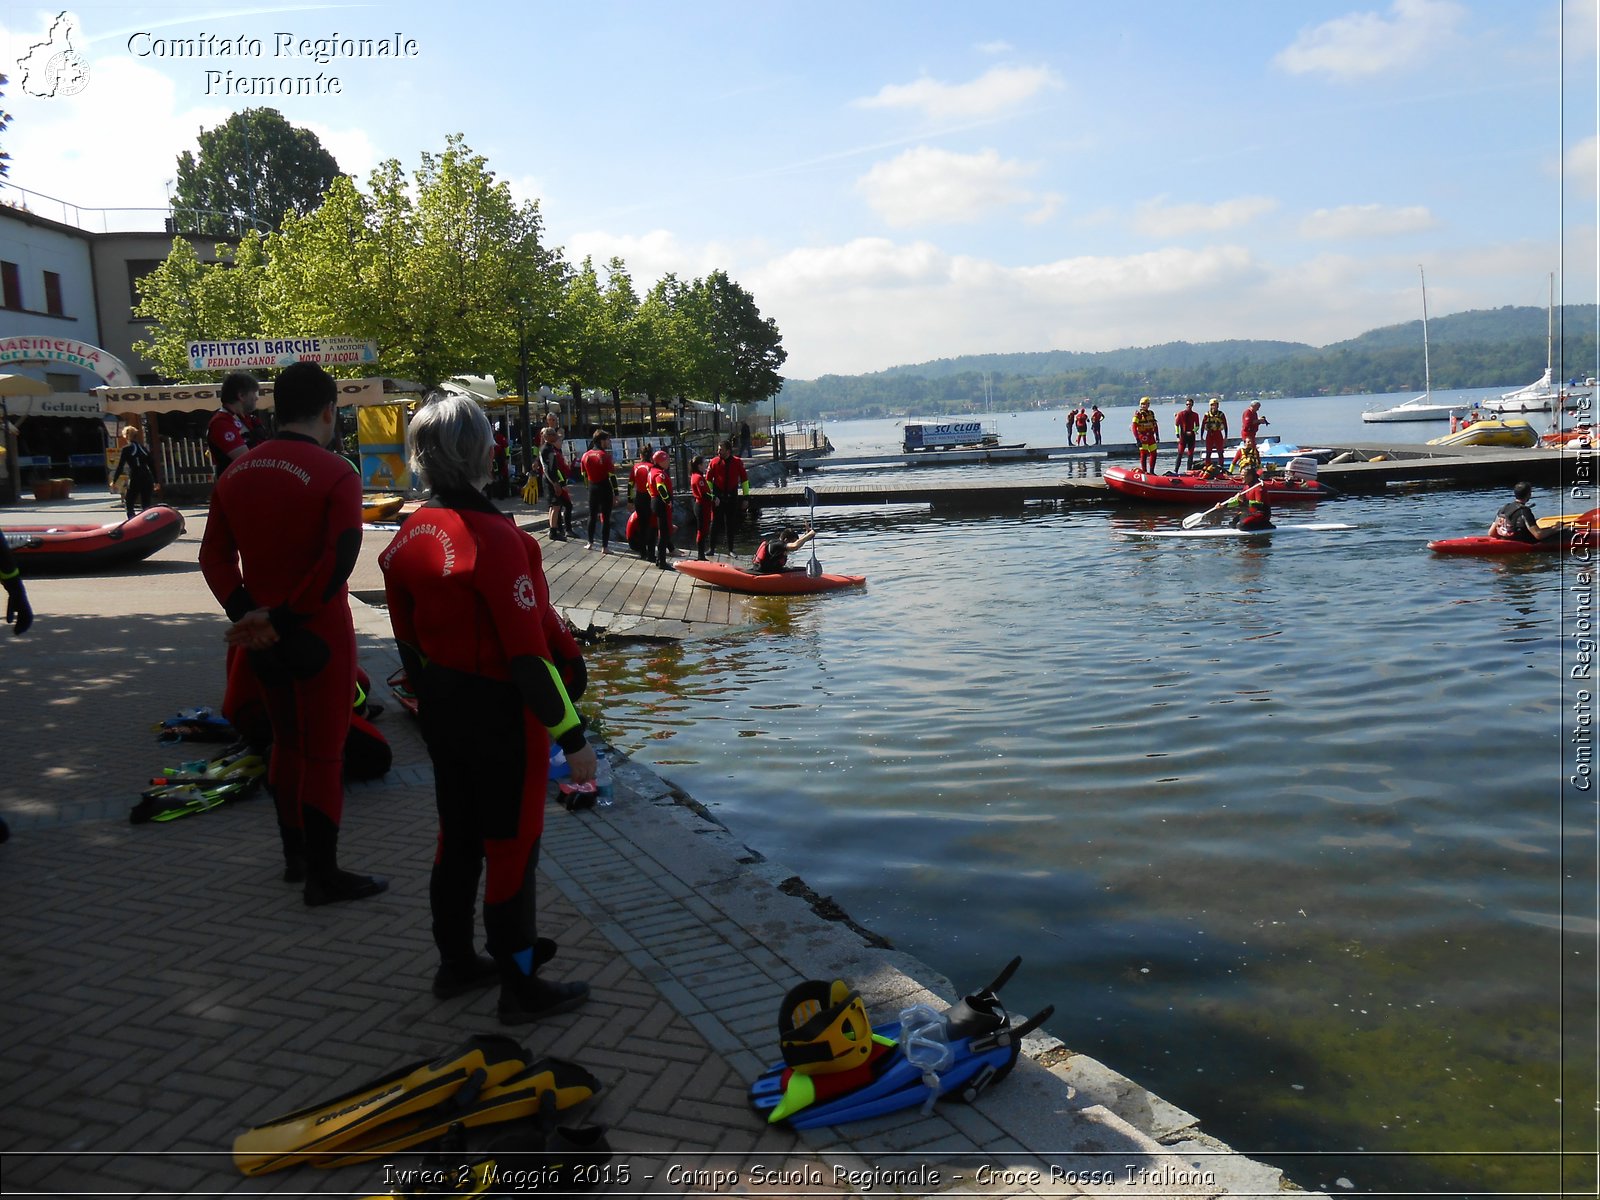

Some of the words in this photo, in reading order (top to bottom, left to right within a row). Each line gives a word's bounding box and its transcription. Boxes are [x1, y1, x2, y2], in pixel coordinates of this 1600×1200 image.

[0, 339, 99, 362] ARINELLA
[190, 342, 259, 358] AFFITTASI
[265, 340, 320, 354] BARCHE
[1, 350, 95, 370] GELATERIA
[105, 391, 222, 402] NOLEGGI
[42, 402, 100, 412] Gelateri
[954, 423, 980, 432] CLUB
[250, 460, 276, 468] ROSSA
[277, 460, 311, 486] ITALIANA
[383, 535, 408, 569] CROCE
[410, 524, 436, 539] ROSSA
[436, 530, 456, 576] ITALIANA
